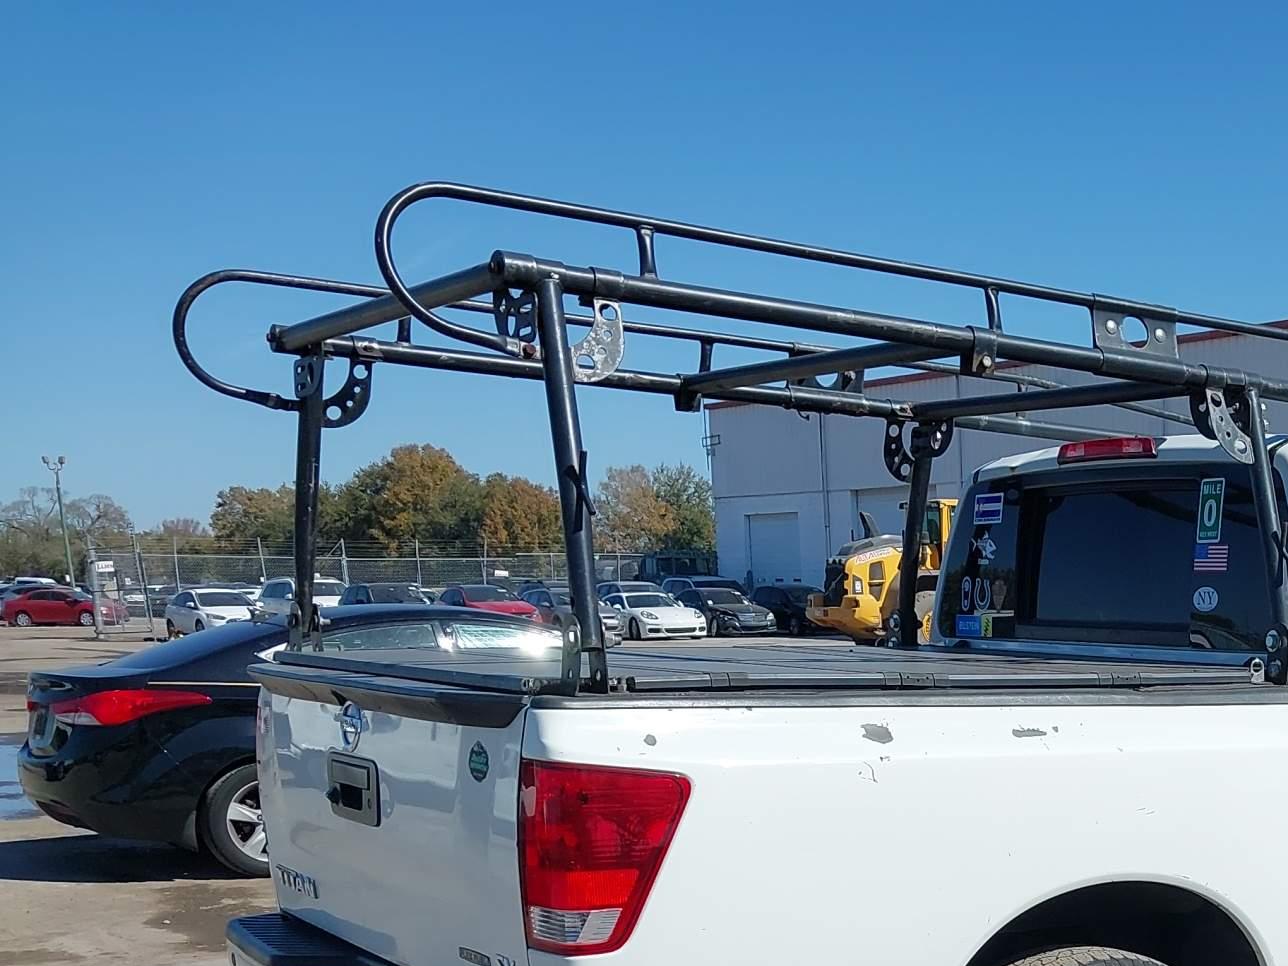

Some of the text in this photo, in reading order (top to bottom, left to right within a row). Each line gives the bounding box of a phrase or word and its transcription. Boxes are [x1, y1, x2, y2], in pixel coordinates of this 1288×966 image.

[1203, 483, 1222, 495] MILE
[1203, 499, 1217, 527] 0
[1197, 590, 1214, 606] NY
[275, 863, 319, 900] TITAN
